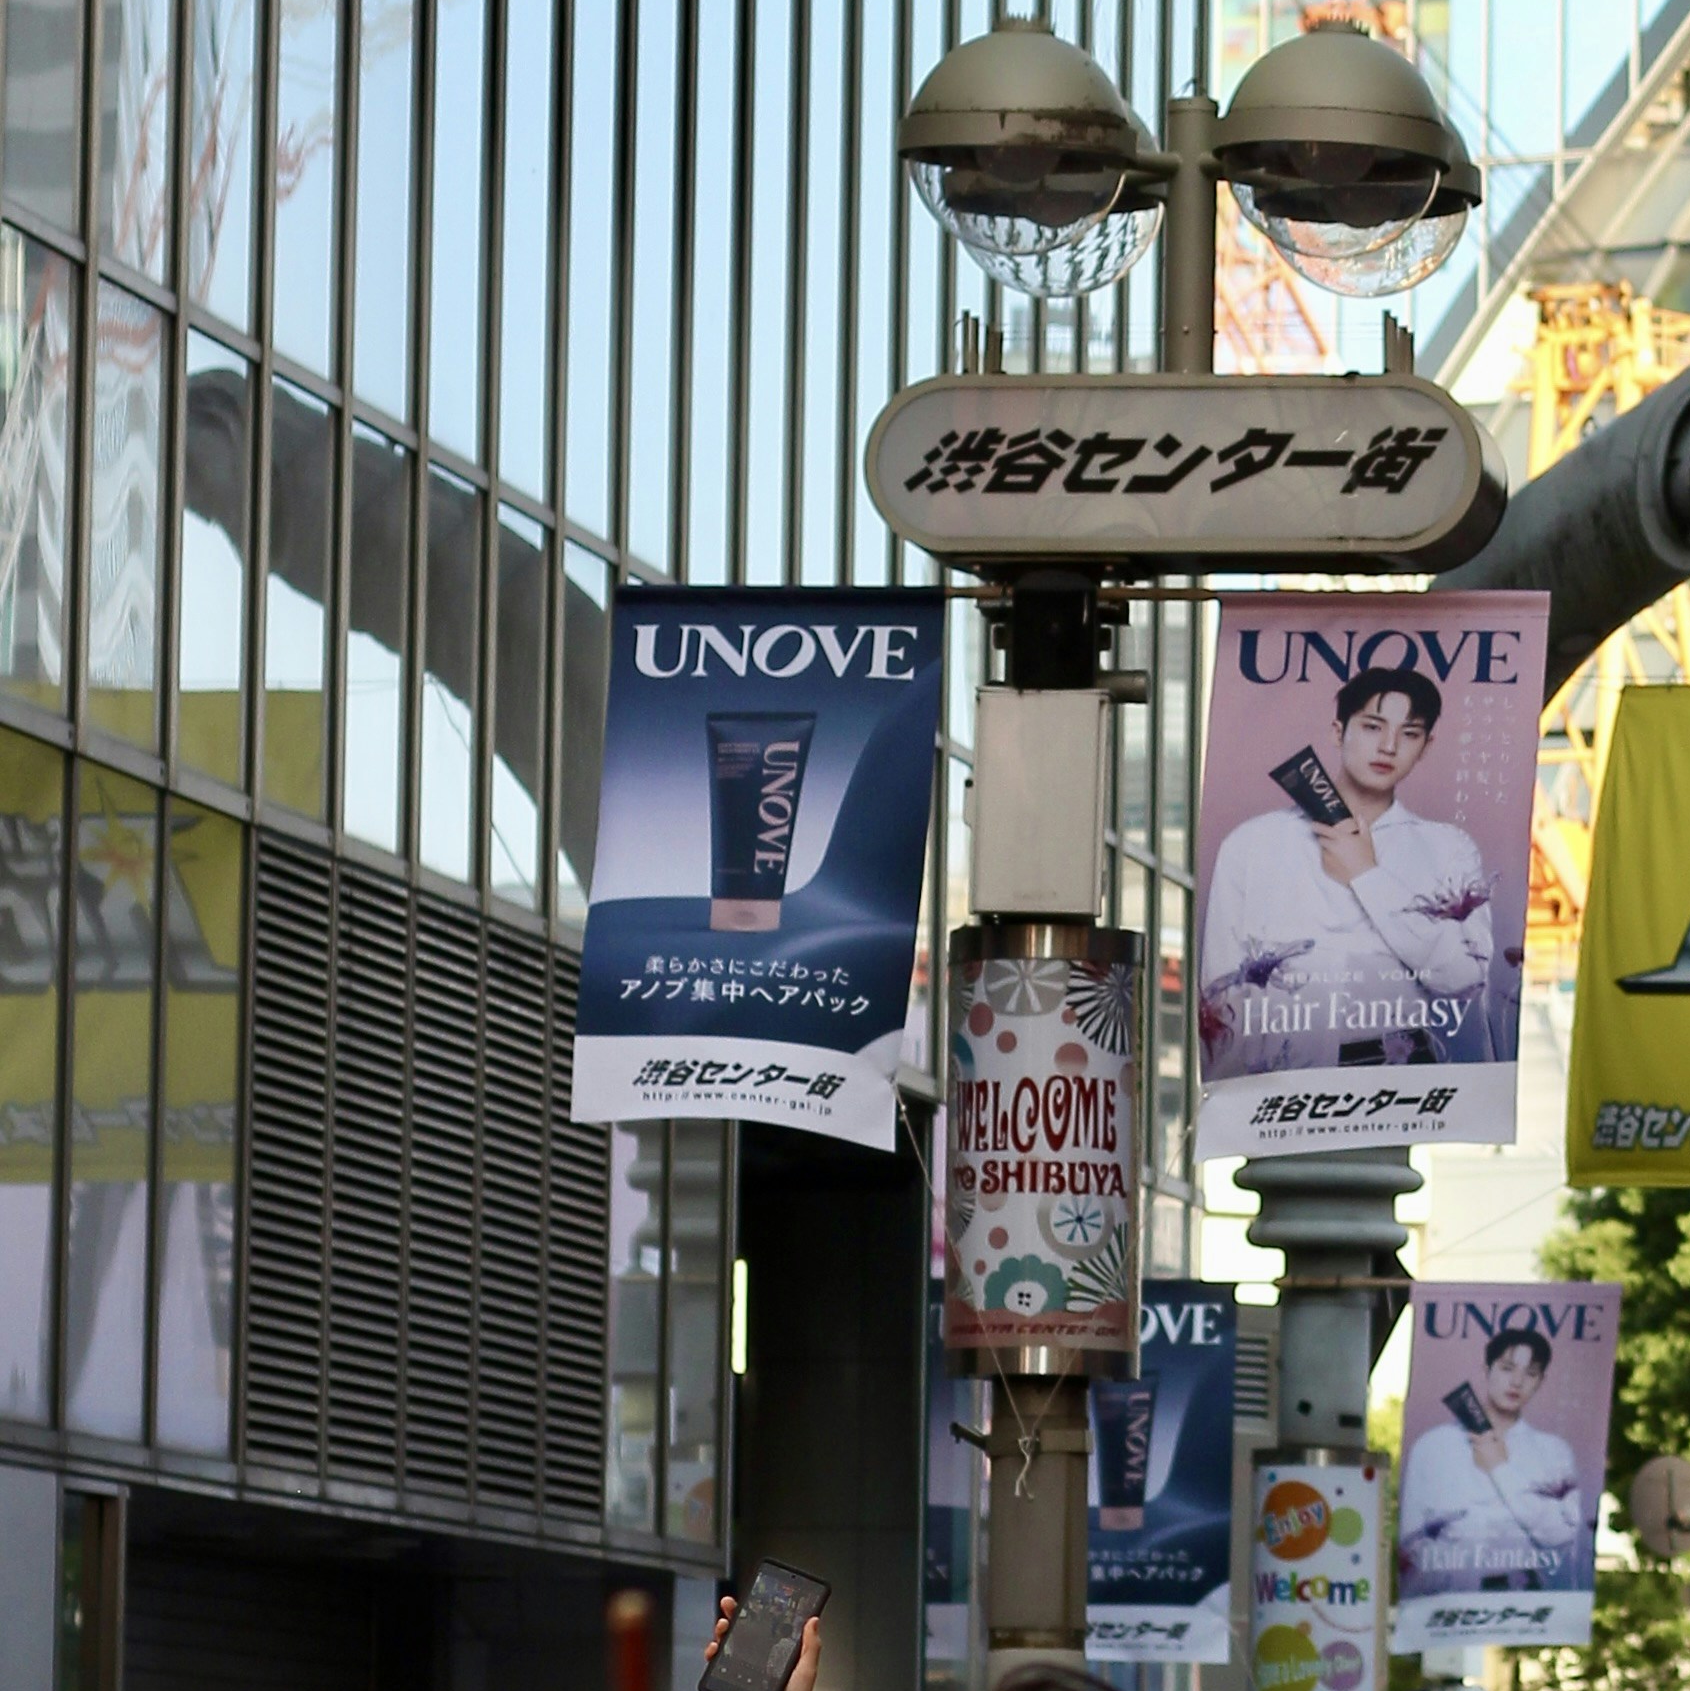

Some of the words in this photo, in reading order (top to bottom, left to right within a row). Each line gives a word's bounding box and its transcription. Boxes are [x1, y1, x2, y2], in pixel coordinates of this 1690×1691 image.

[903, 426, 1448, 494] 渋谷センター街
[634, 624, 918, 680] UNOVE
[1237, 629, 1520, 685] UNOVE
[754, 741, 799, 875] UNOVE
[644, 956, 850, 985] 柔らかさにこだわった
[619, 978, 871, 1016] アノブ集中ヘアパック
[1243, 993, 1320, 1037] Hair
[1328, 991, 1472, 1037] Fantasy
[633, 1058, 846, 1100] 渋谷センター街
[957, 1075, 1116, 1153] WELCOME
[1250, 1087, 1458, 1125] 渋谷センター街
[981, 1160, 1127, 1198] SHIBUYA
[1424, 1302, 1604, 1342] UNOVE
[1256, 1571, 1370, 1605] Welcome
